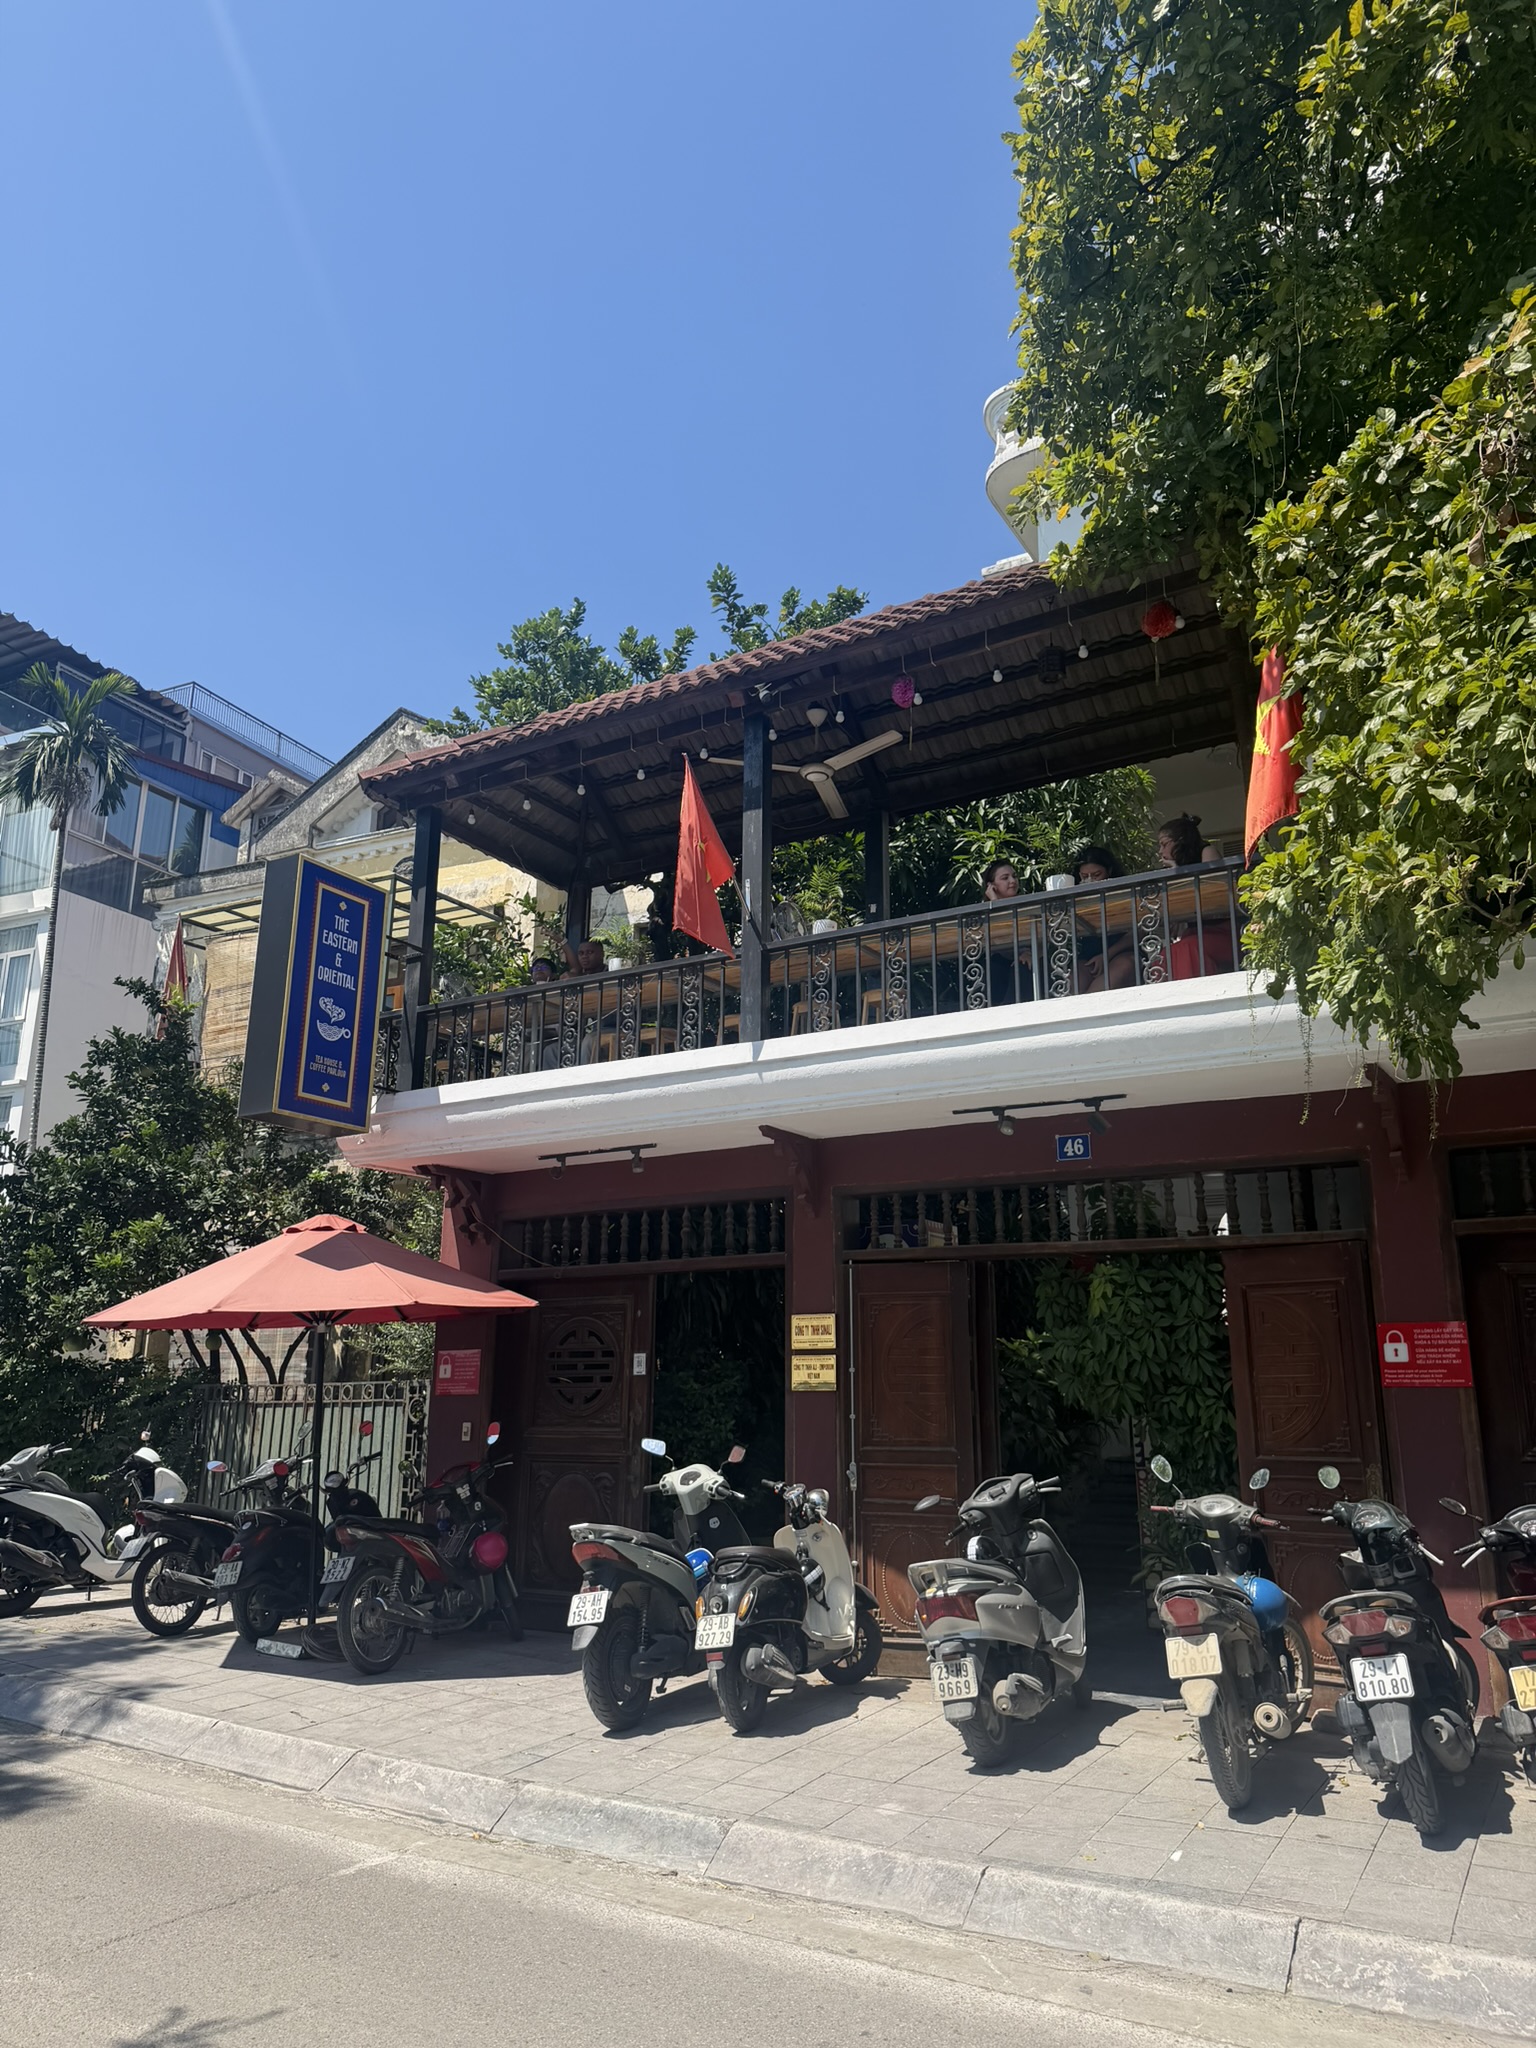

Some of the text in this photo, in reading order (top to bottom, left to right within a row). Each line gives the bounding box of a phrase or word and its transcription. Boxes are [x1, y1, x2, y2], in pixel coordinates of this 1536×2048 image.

[335, 915, 350, 933] THE
[323, 929, 358, 955] EASTERN
[335, 953, 342, 968] &
[318, 965, 356, 991] ORIENTAL
[310, 1062, 326, 1073] COFFEE
[315, 1055, 323, 1063] TEA
[1063, 1138, 1084, 1156] 46
[576, 1593, 602, 1609] 29-AH
[572, 1607, 603, 1624] 154.95
[703, 1616, 729, 1631] 29-AB
[698, 1630, 731, 1646] 927.29
[1360, 1658, 1399, 1678] 29-L1
[939, 1680, 971, 1698] 9669
[1359, 1677, 1409, 1698] 810.80
